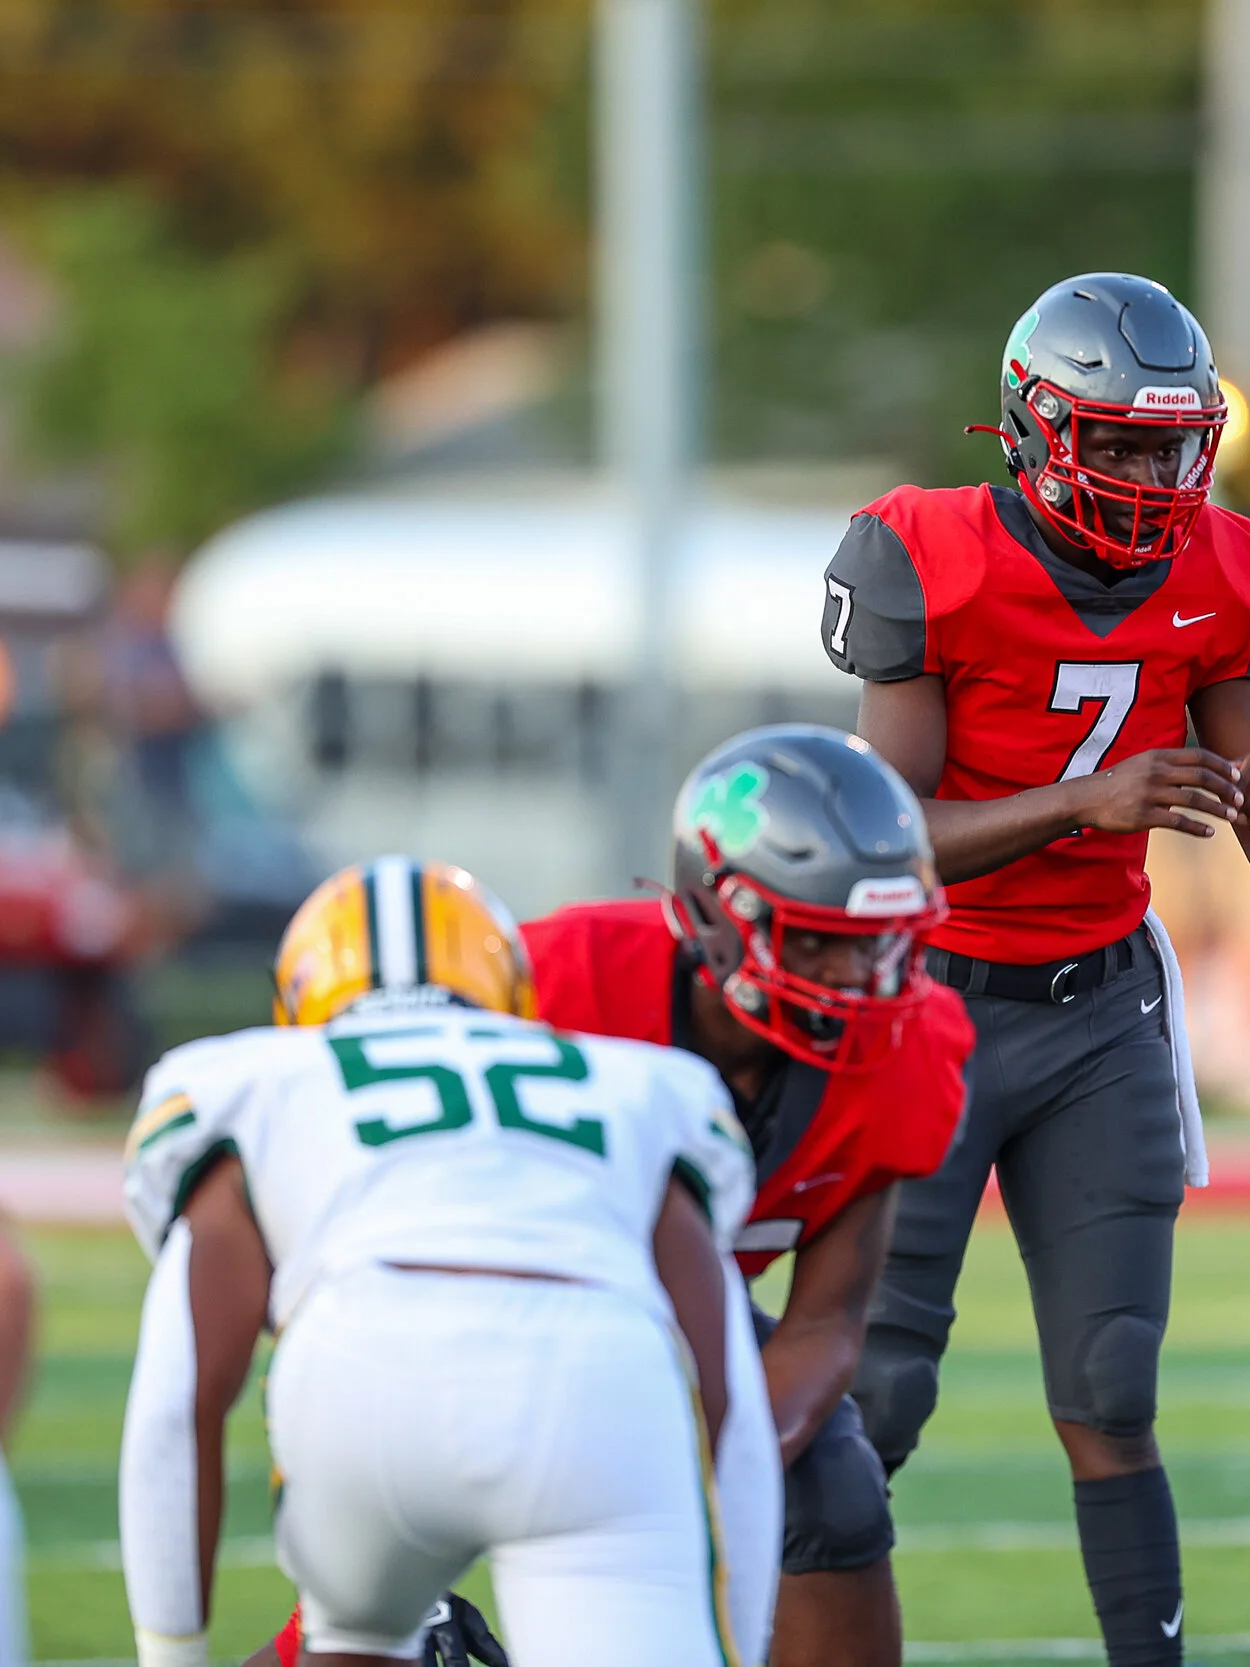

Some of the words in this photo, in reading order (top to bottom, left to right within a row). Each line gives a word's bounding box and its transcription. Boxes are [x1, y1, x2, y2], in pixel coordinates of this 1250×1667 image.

[1146, 392, 1195, 404] Riddell
[828, 573, 856, 660] 7
[1046, 660, 1144, 786] 7
[329, 1025, 607, 1158] 52
